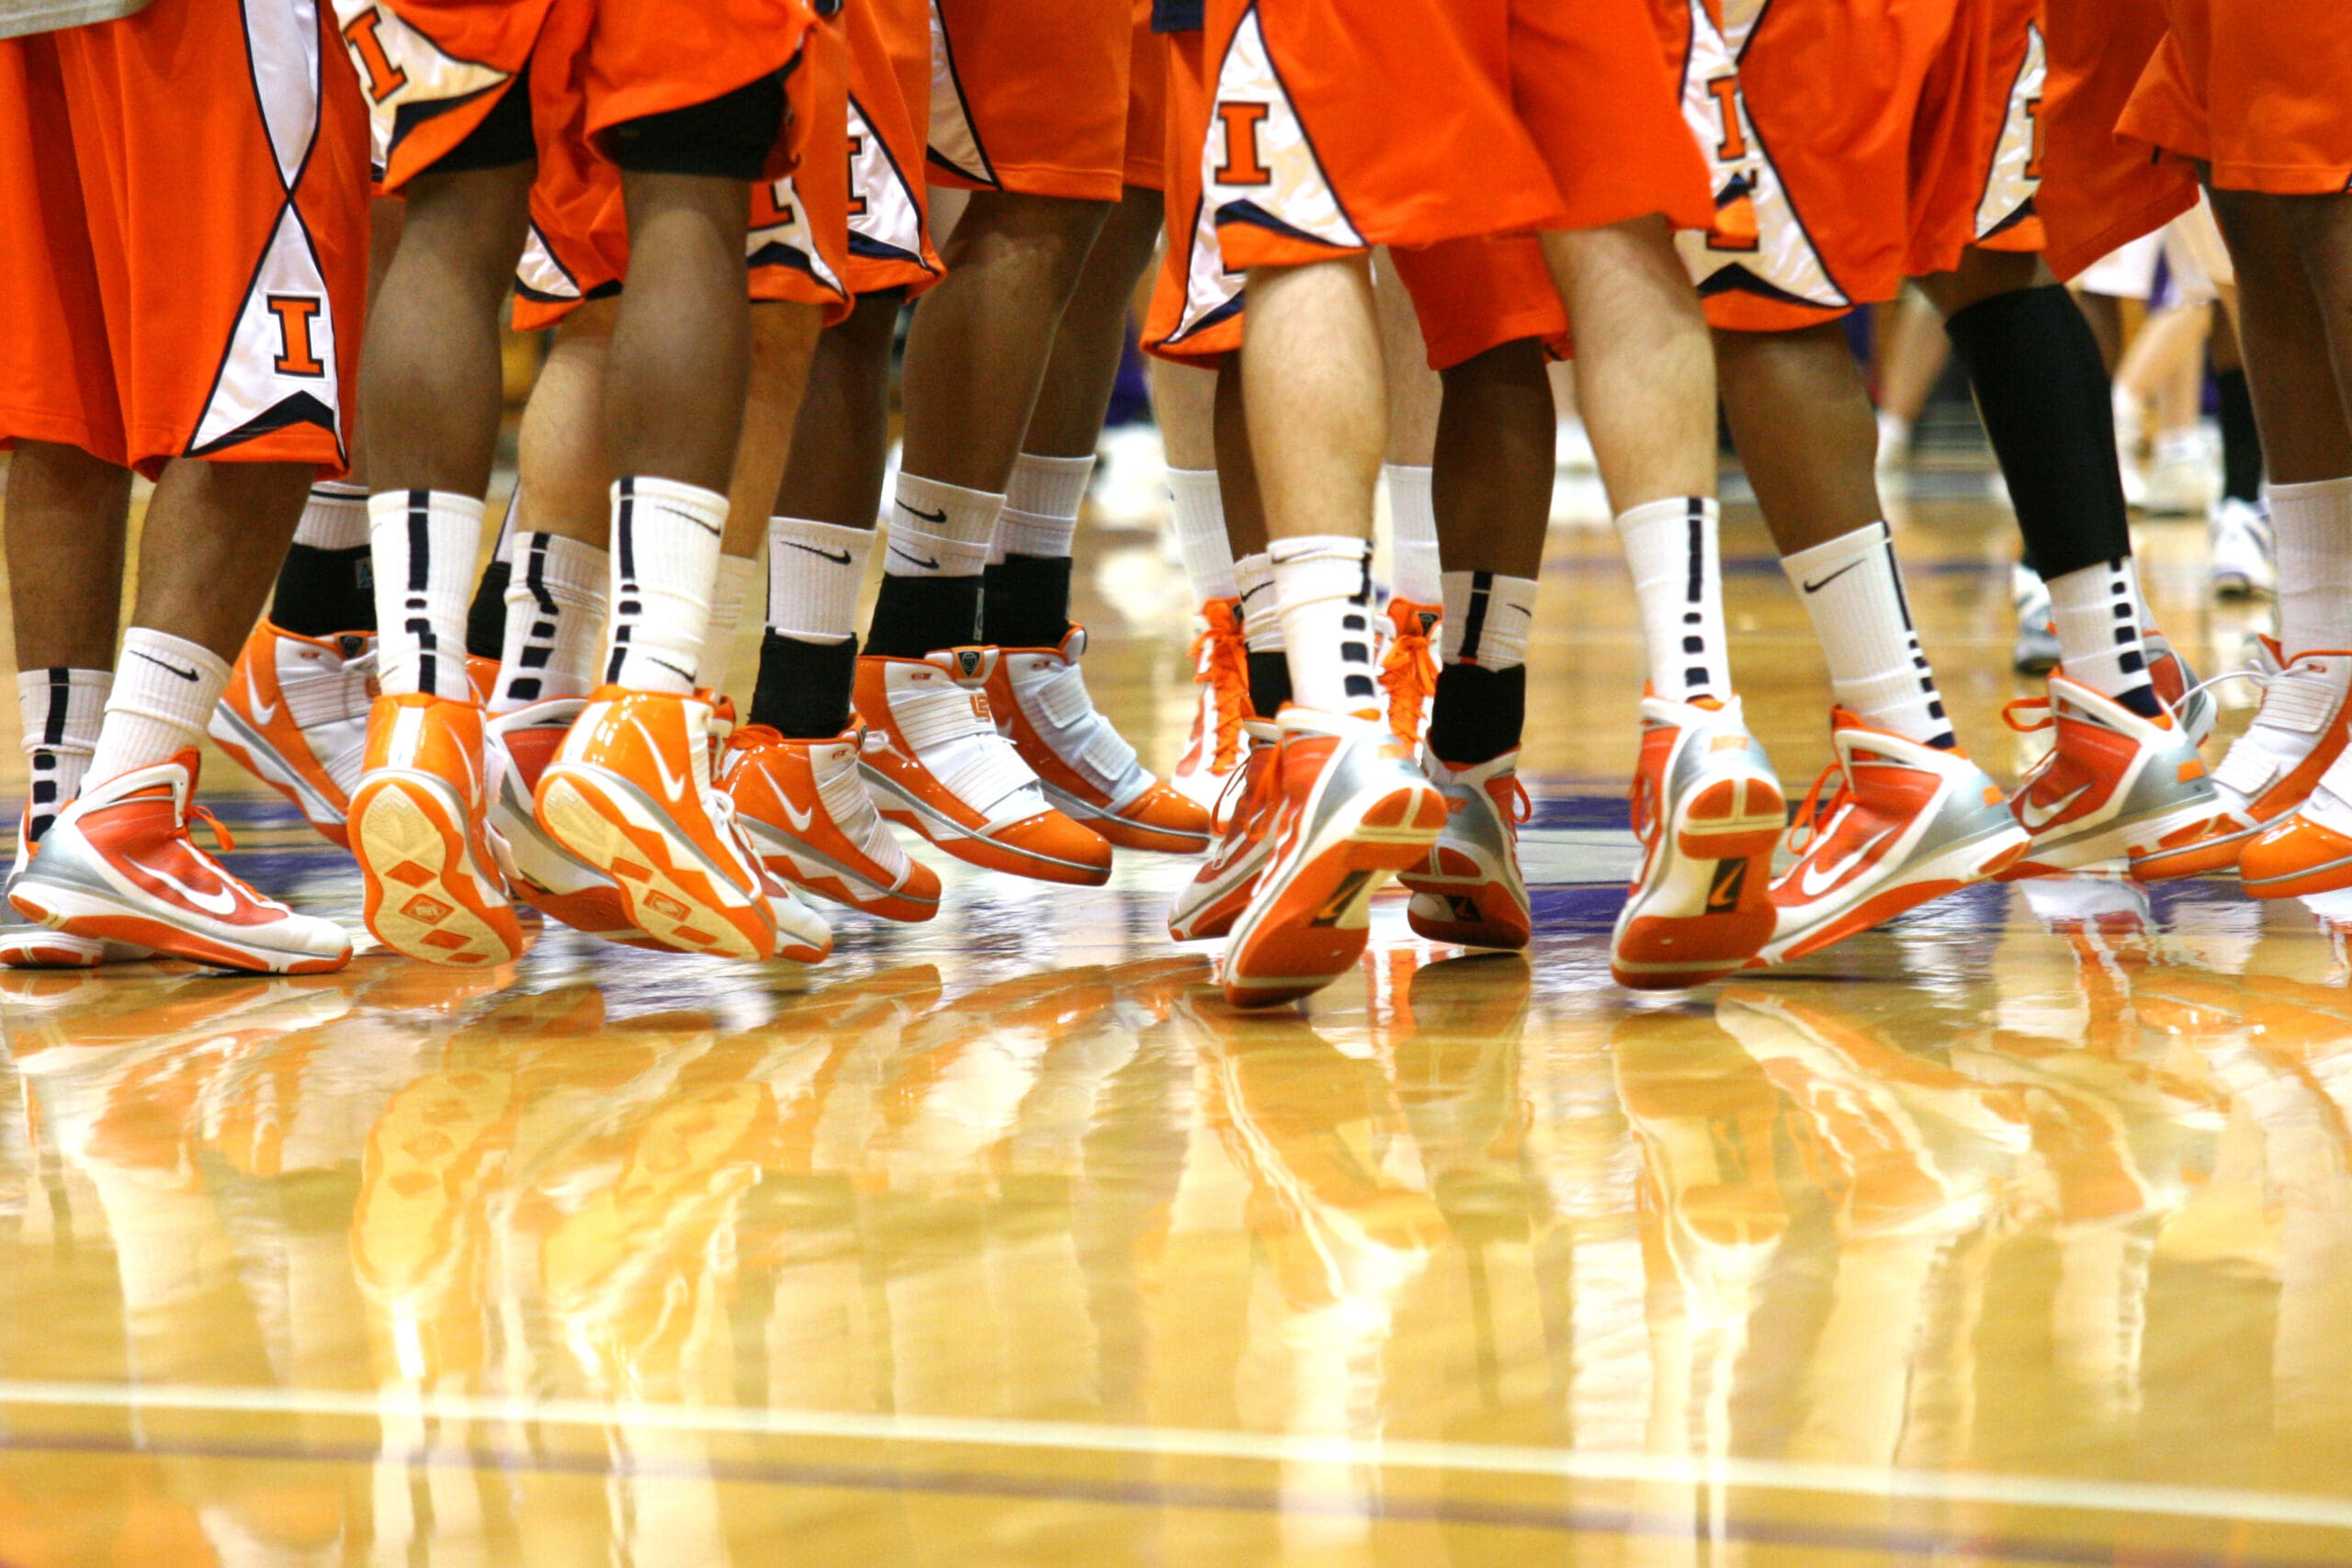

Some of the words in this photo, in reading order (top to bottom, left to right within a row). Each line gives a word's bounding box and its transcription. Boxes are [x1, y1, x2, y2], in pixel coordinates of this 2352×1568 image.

[343, 5, 409, 106] I
[1215, 101, 1271, 186] I
[1707, 75, 1747, 162] I
[266, 294, 324, 378] I
